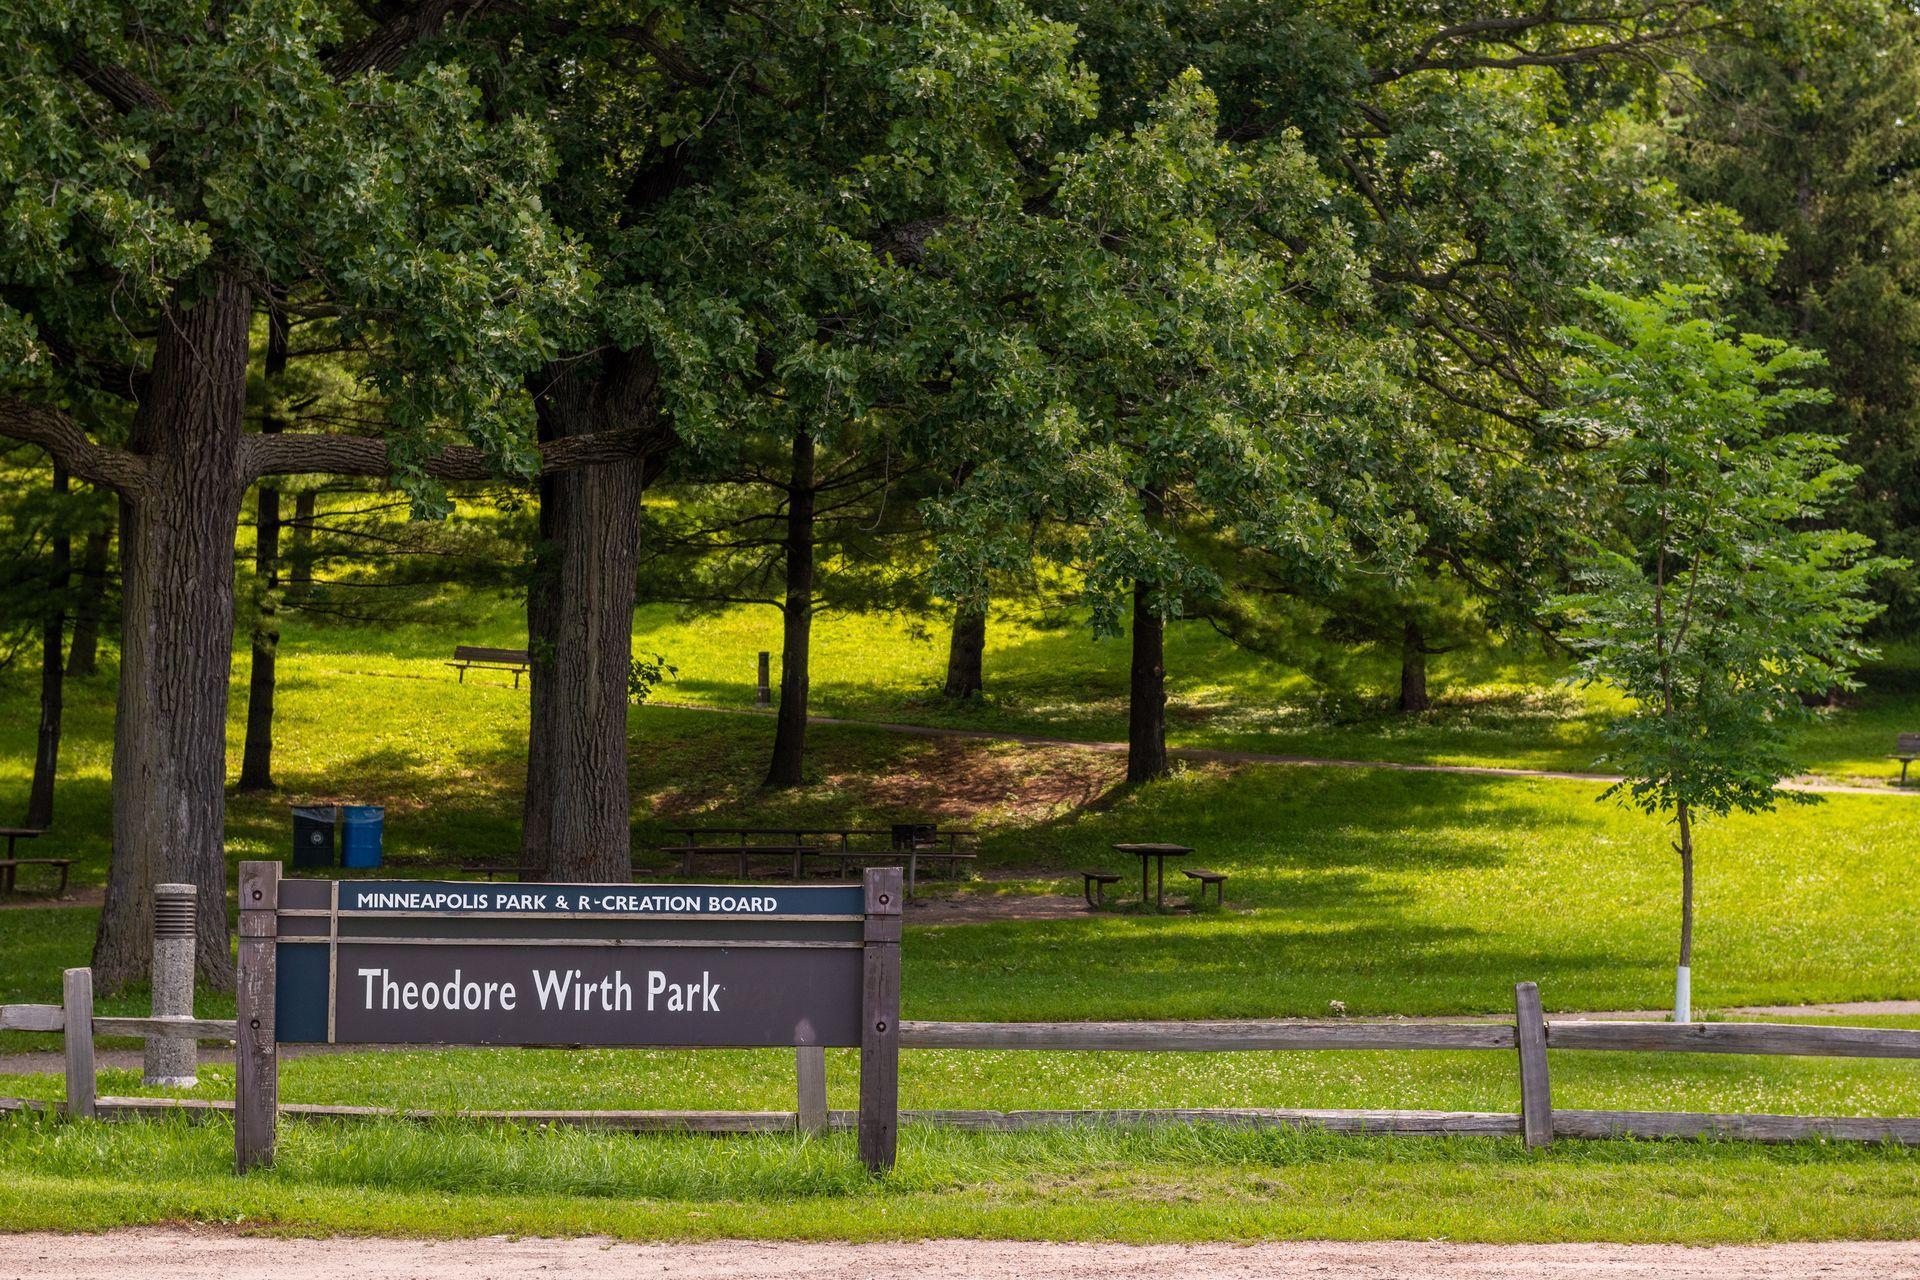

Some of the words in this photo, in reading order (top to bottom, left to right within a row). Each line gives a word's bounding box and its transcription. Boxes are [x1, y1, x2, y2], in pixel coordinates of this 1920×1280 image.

[357, 893, 489, 909] MINNEAPOLIS
[496, 894, 547, 910] PARK
[555, 895, 570, 910] &
[578, 895, 701, 912] RCREATION
[708, 896, 778, 912] BOARD
[358, 968, 517, 1011] Theodore
[532, 969, 632, 1012] Wirth
[647, 970, 721, 1012] Park
